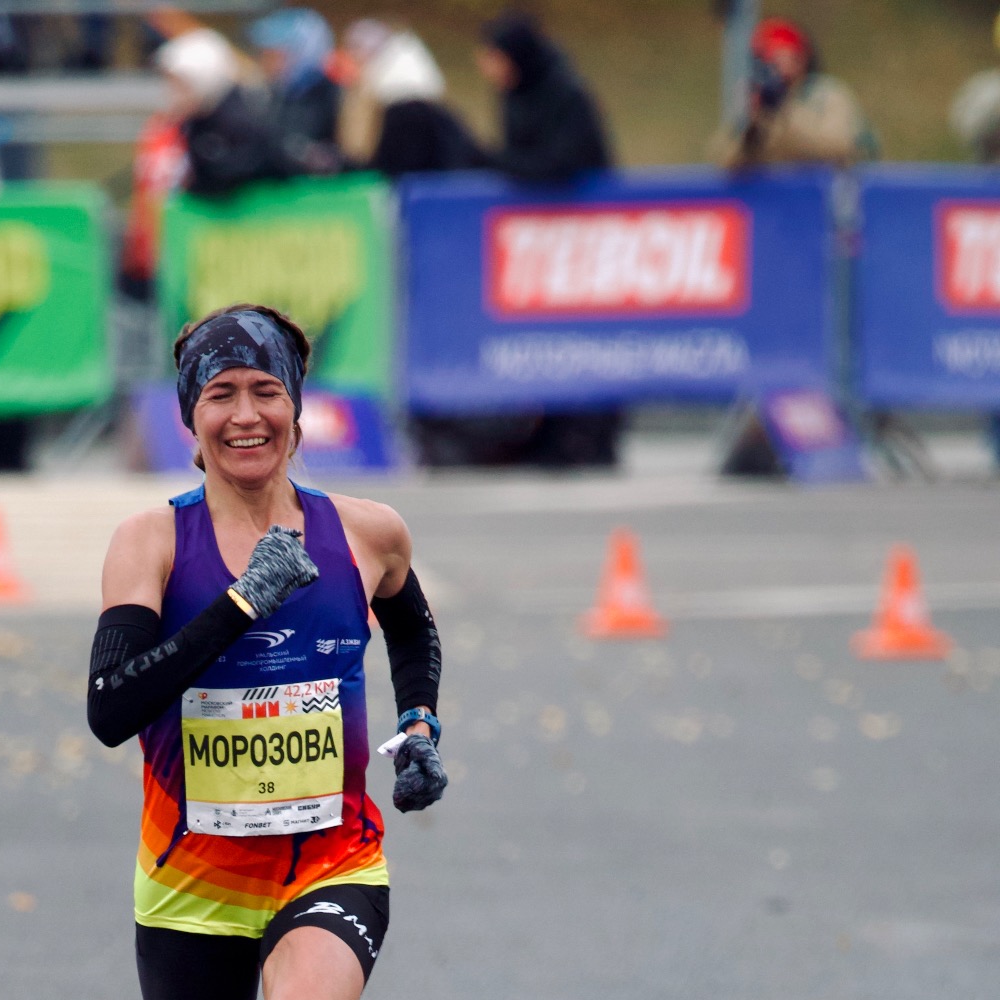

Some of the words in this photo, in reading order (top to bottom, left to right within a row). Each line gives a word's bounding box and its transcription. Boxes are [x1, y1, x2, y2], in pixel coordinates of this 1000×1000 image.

[109, 640, 179, 691] FALKE
[283, 683, 312, 698] 42,2
[188, 726, 338, 768] МОРОЗОВА
[258, 782, 275, 794] 38
[244, 821, 272, 829] FONBET
